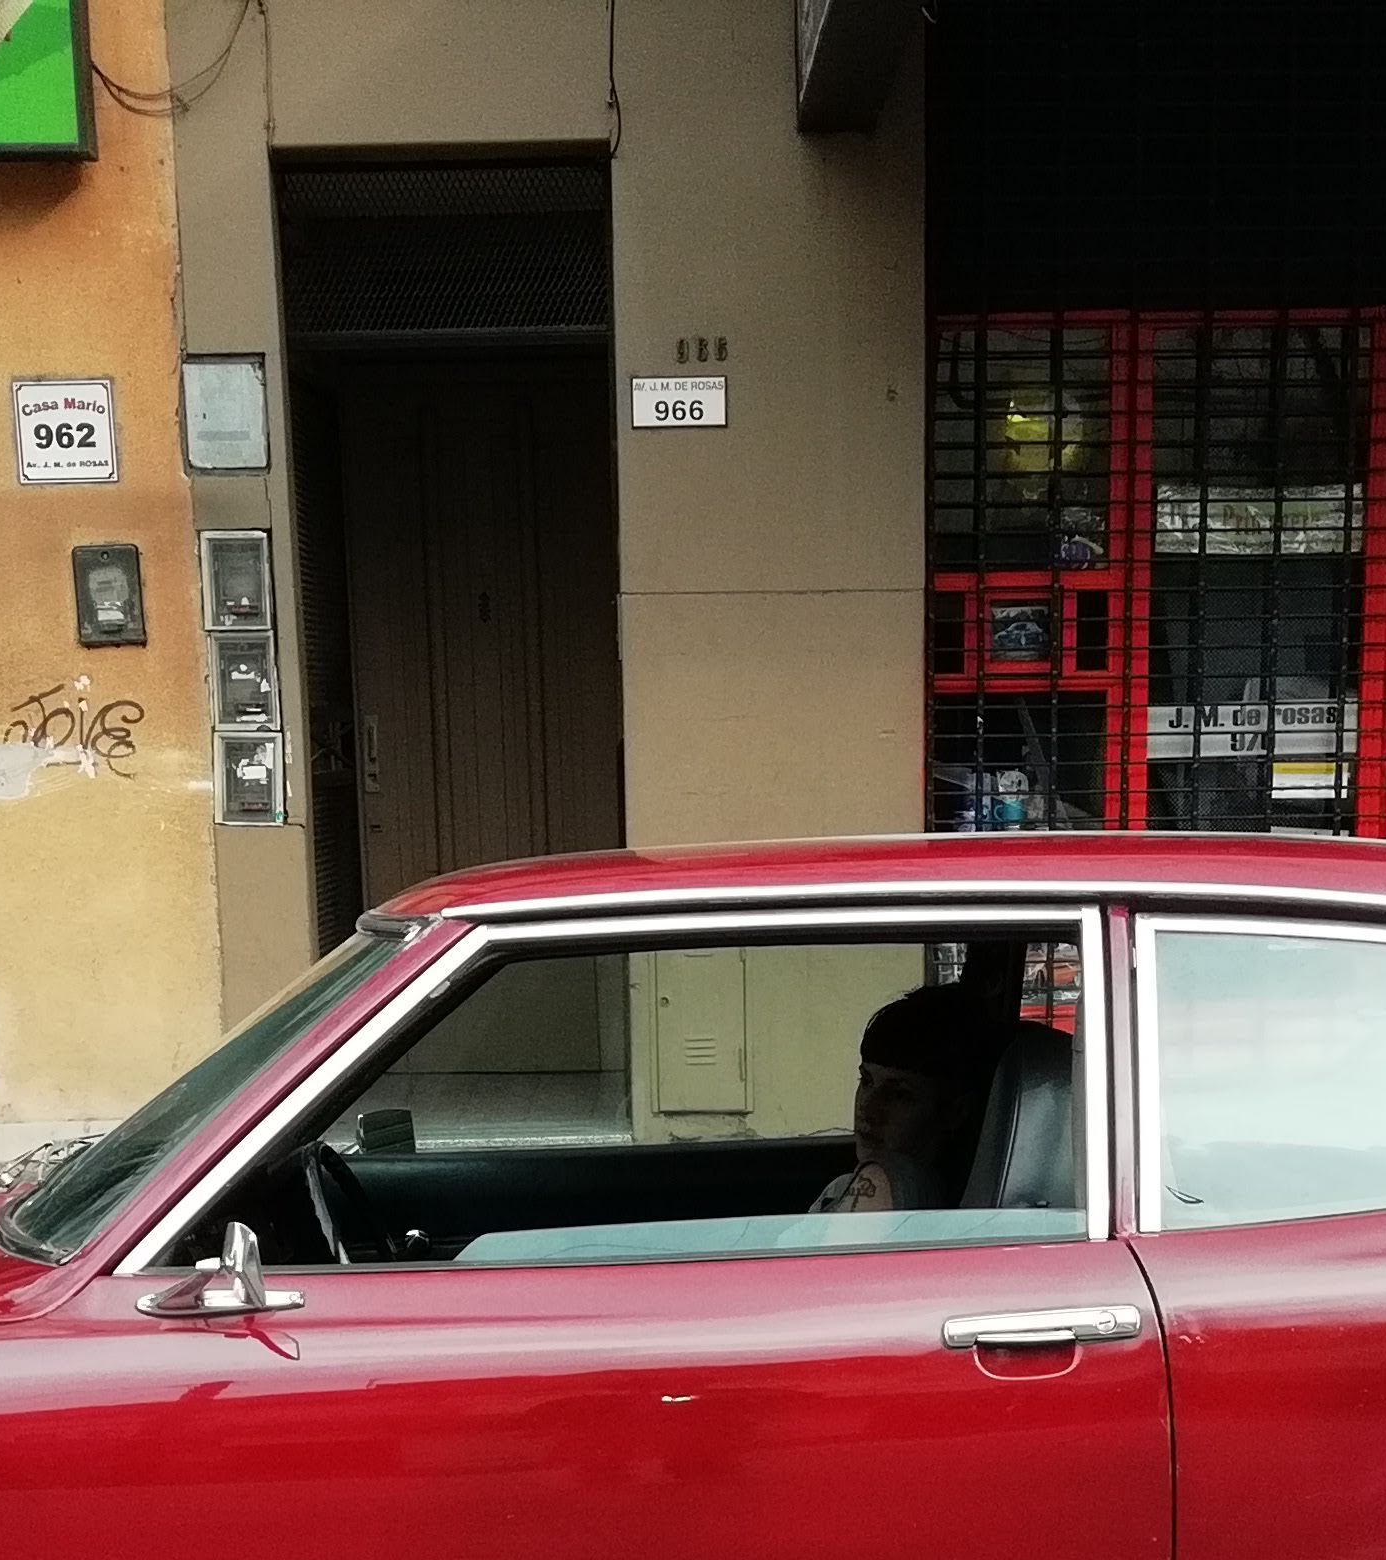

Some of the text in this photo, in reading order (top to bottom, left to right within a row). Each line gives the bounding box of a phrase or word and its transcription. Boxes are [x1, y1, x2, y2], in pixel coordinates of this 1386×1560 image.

[633, 382, 647, 392] AV.
[674, 381, 688, 391] DE
[691, 381, 724, 391] ROSAS
[21, 397, 106, 416] Casa Mario
[655, 400, 704, 421] 966
[33, 422, 97, 449] 962
[1232, 706, 1261, 727] de
[1230, 732, 1268, 752] 97
